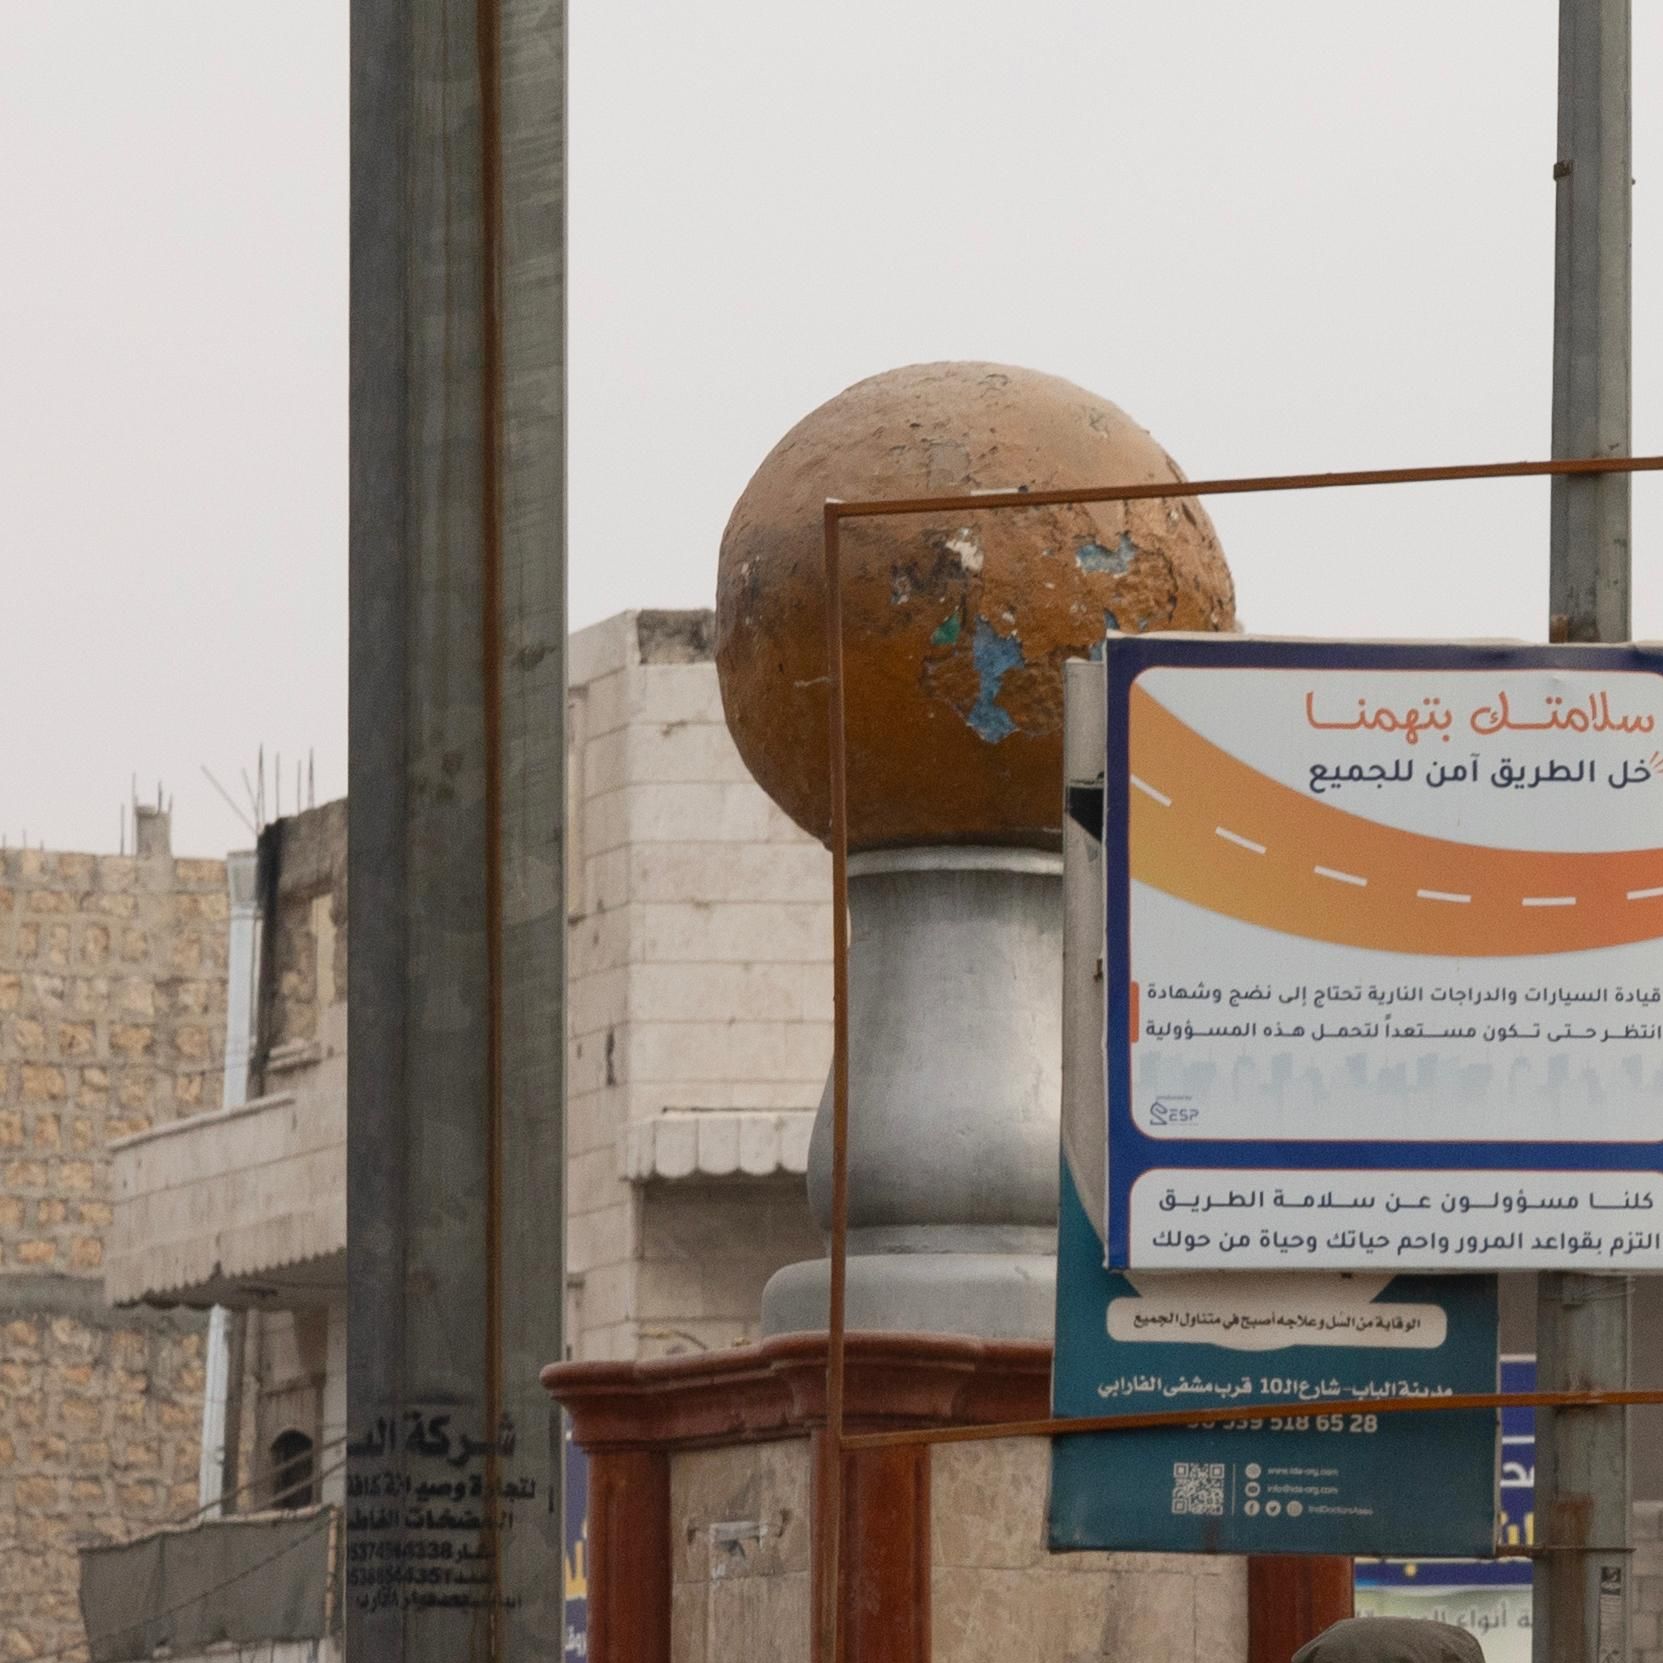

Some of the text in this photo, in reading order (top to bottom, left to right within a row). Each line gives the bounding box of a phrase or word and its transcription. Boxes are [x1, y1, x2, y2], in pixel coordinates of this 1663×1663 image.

[1305, 691, 1655, 745] سلامتك بتهمنا
[1309, 752, 1652, 794] خل الطريق آمن للجميع
[1147, 983, 1662, 1008] قيادة السيارات والدراجات النارية تحتاج إلى نضج وشهادة
[1145, 1021, 1256, 1041] المسؤولية
[1263, 1022, 1306, 1040] هذه
[1311, 1022, 1380, 1041] لتحمل
[1483, 1022, 1540, 1041] تكون
[1547, 1023, 1597, 1041] حتى
[1601, 1023, 1662, 1042] انتظر
[1158, 1188, 1654, 1213] كلنا مسؤولون عن سلامة الطريق
[1152, 1230, 1661, 1256] التزم بقواعد المرور واحم حياتك وحياة من حولك
[1134, 1312, 1179, 1328] الجميع
[1178, 1312, 1221, 1328] متناول
[1222, 1313, 1239, 1329] في
[1241, 1311, 1276, 1329] أصبح
[1356, 1316, 1373, 1331] من
[1376, 1316, 1421, 1333] الوقاية
[1097, 1375, 1162, 1398] الفارابي
[1163, 1375, 1213, 1396] مشفى
[1214, 1375, 1253, 1398] قرب
[1316, 1414, 1344, 1432] 65
[1350, 1414, 1378, 1433] 28
